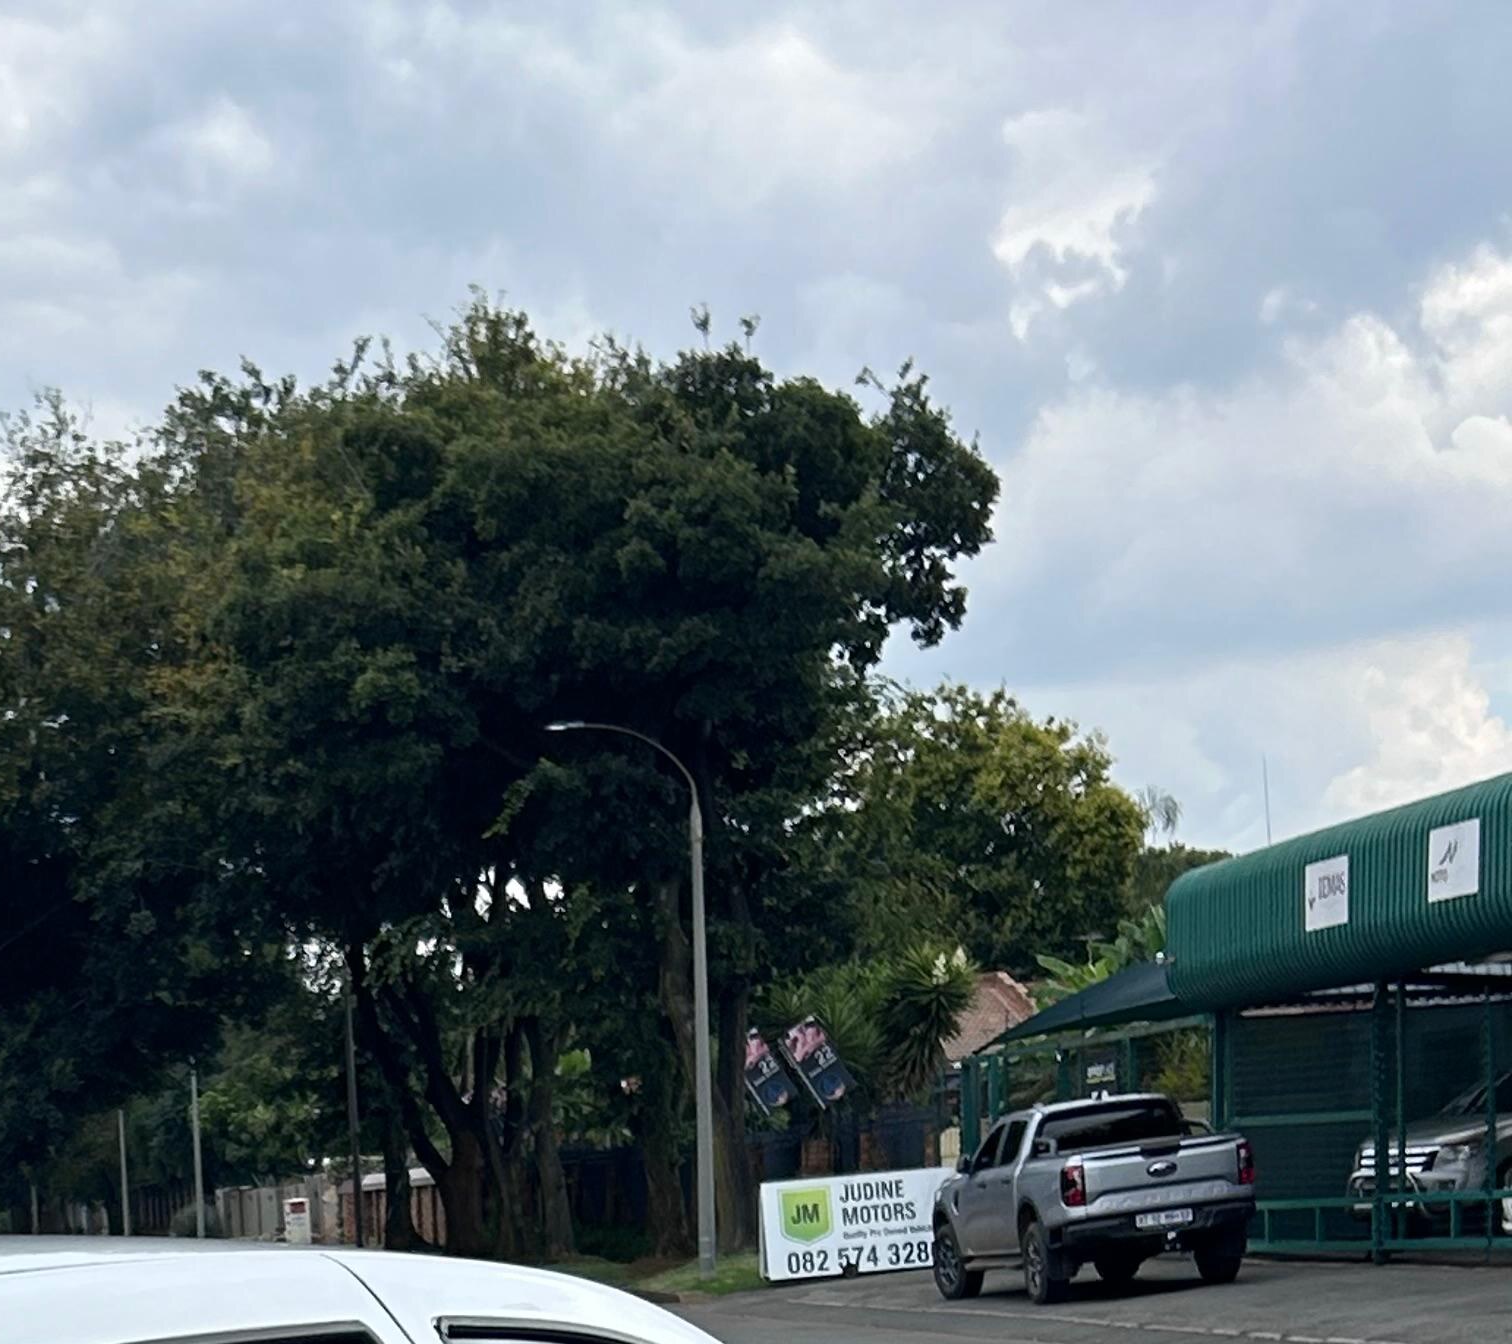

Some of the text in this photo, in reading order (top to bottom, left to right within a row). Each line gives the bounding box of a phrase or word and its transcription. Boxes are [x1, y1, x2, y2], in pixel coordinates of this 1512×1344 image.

[840, 1179, 905, 1203] JUDINE
[791, 1203, 820, 1225] JM
[842, 1202, 917, 1226] MOTORS
[787, 1240, 934, 1275] 082 574 328
